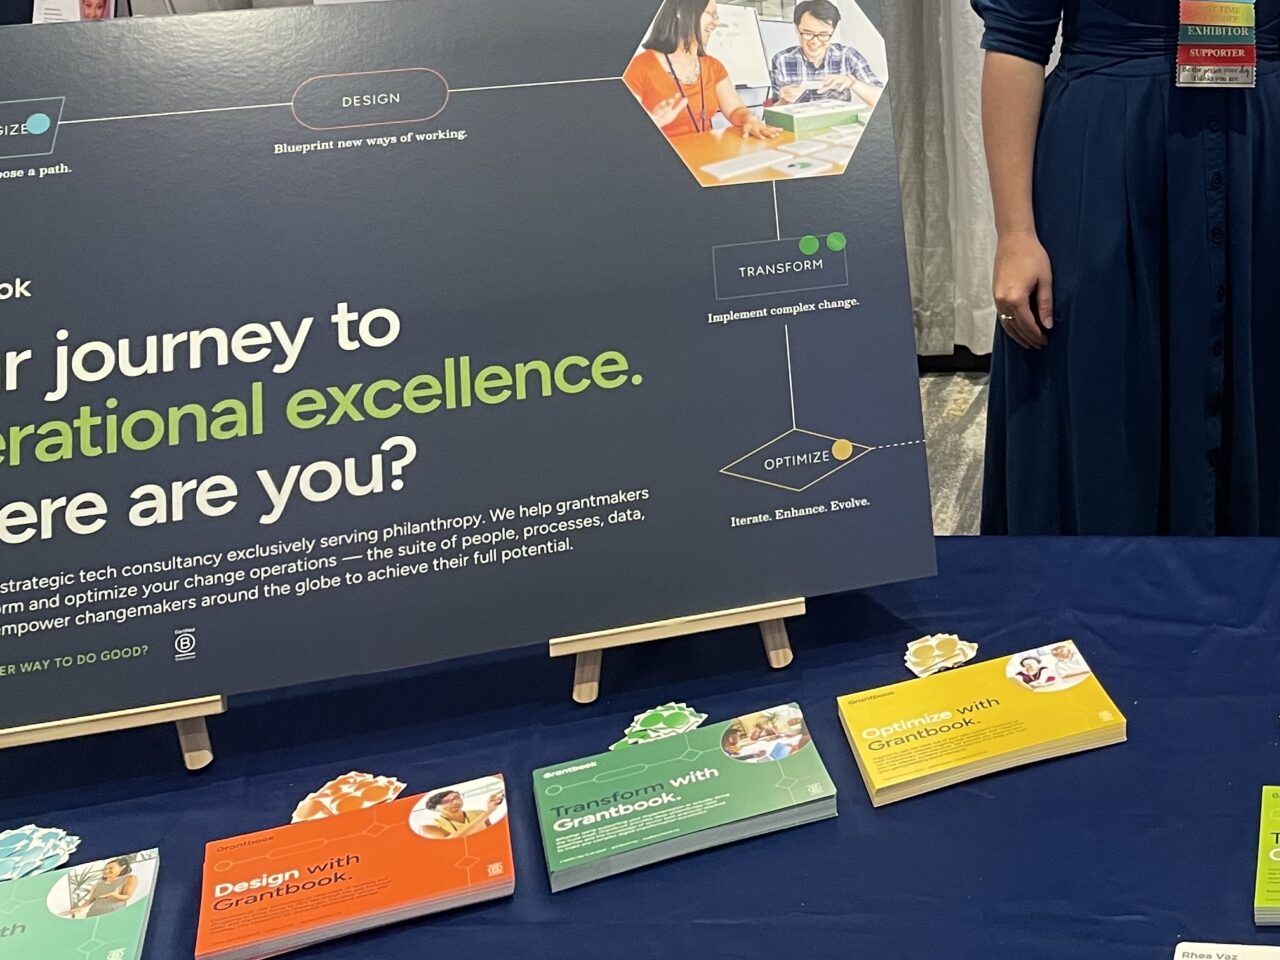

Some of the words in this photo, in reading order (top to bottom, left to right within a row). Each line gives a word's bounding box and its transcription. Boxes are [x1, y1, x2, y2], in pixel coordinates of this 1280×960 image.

[1187, 26, 1249, 36] EXHIBITOR
[1189, 48, 1245, 57] SUPPORTER
[342, 92, 401, 108] DESIGN
[274, 139, 334, 154] Blueprint
[337, 138, 363, 149] new
[367, 135, 397, 148] ways
[400, 132, 413, 144] of
[416, 129, 468, 145] working.
[28, 168, 35, 176] a
[39, 163, 72, 178] path.
[738, 259, 824, 278] TRANSFORM
[708, 307, 767, 325] Implement
[770, 302, 816, 317] complex
[818, 297, 860, 313] change.
[44, 317, 314, 402] journey
[330, 302, 401, 351] to
[0, 381, 263, 466] rational
[286, 350, 643, 428] excellence.
[764, 450, 830, 471] OPTIMIZE
[128, 472, 238, 527] are
[256, 435, 417, 525] you?
[731, 512, 773, 527] Iterate.
[775, 504, 829, 522] Enhance.
[830, 497, 871, 513] Evolve.
[0, 572, 75, 594] strategic
[79, 566, 117, 583] tech
[122, 552, 222, 577] consultancy
[227, 537, 316, 562] exclusively
[320, 529, 378, 548] serving
[383, 513, 486, 541] philanthropy.
[489, 507, 515, 522] We
[519, 502, 552, 518] help
[556, 488, 650, 515] grantmakers
[0, 604, 24, 616] rm
[29, 594, 60, 611] and
[64, 585, 138, 607] optimize
[142, 579, 179, 598] your
[184, 569, 246, 589] change
[249, 556, 337, 581] operations
[366, 547, 394, 561] the
[398, 537, 437, 557] suite
[440, 534, 457, 551] of
[461, 527, 519, 549] people,
[523, 515, 604, 540] processes,
[608, 508, 645, 524] data,
[0, 615, 70, 637] mpower
[75, 597, 197, 626] changemakers
[201, 586, 259, 607] around
[263, 582, 291, 598] the
[295, 575, 341, 596] globe
[345, 572, 363, 585] to
[367, 562, 428, 582] achieve
[432, 555, 470, 572] their
[473, 548, 497, 565] full
[501, 537, 574, 564] potential.
[20, 659, 50, 673] WAY
[54, 656, 73, 668] TO
[77, 652, 96, 665] DO
[100, 645, 149, 661] GOOD?
[862, 711, 952, 740] Optimize
[956, 698, 1000, 715] with
[868, 718, 981, 751] Grantbook.
[542, 761, 597, 779] Grantbook
[551, 782, 664, 817] Transform
[669, 768, 719, 787] with
[553, 792, 682, 832] Grantbook.
[213, 872, 353, 911] Grantbook.
[215, 869, 300, 898] Design
[307, 853, 360, 875] with
